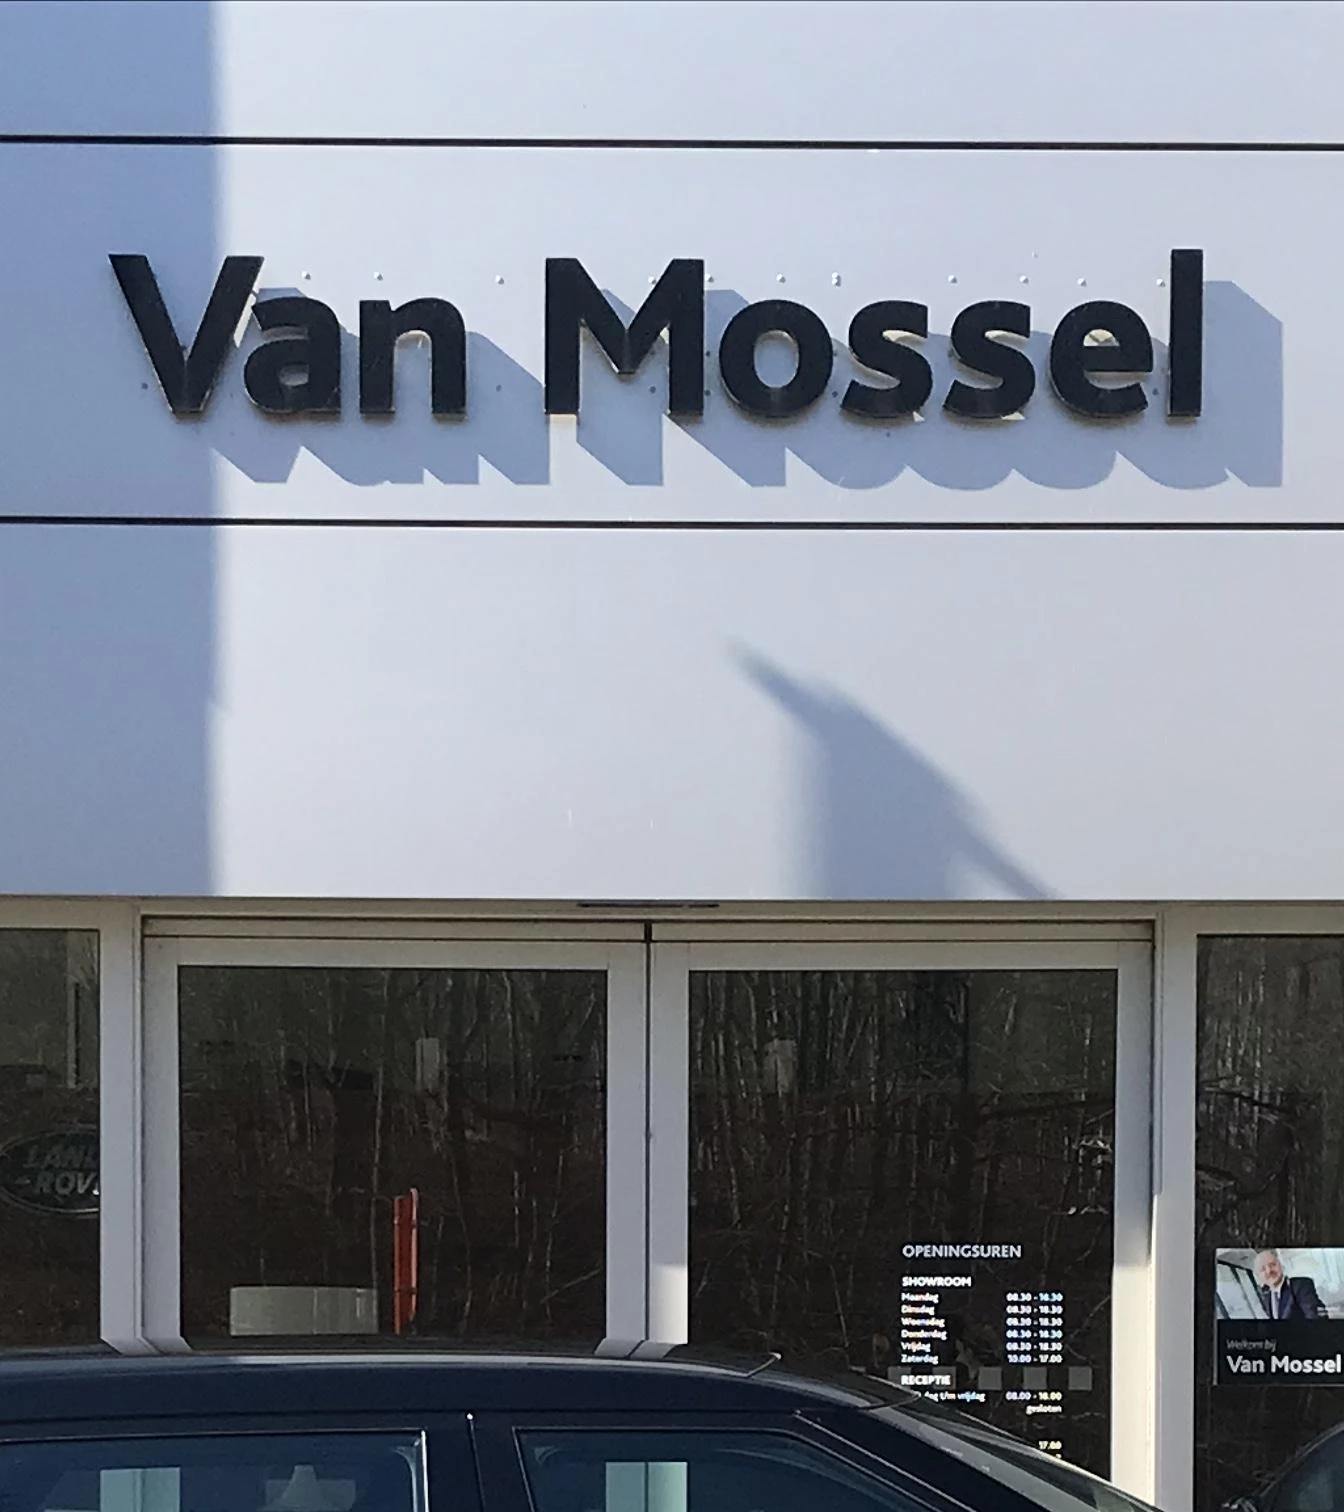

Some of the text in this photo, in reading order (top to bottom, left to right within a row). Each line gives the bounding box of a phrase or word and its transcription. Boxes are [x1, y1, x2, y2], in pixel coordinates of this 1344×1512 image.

[109, 249, 1202, 419] Van Mossel
[32, 1170, 99, 1196] ROV
[902, 1245, 1022, 1258] OPENINGSUREN
[902, 1276, 972, 1287] SHOWROOM
[1226, 1353, 1342, 1373] Van Mossel
[901, 1375, 951, 1385] RECEPTIE
